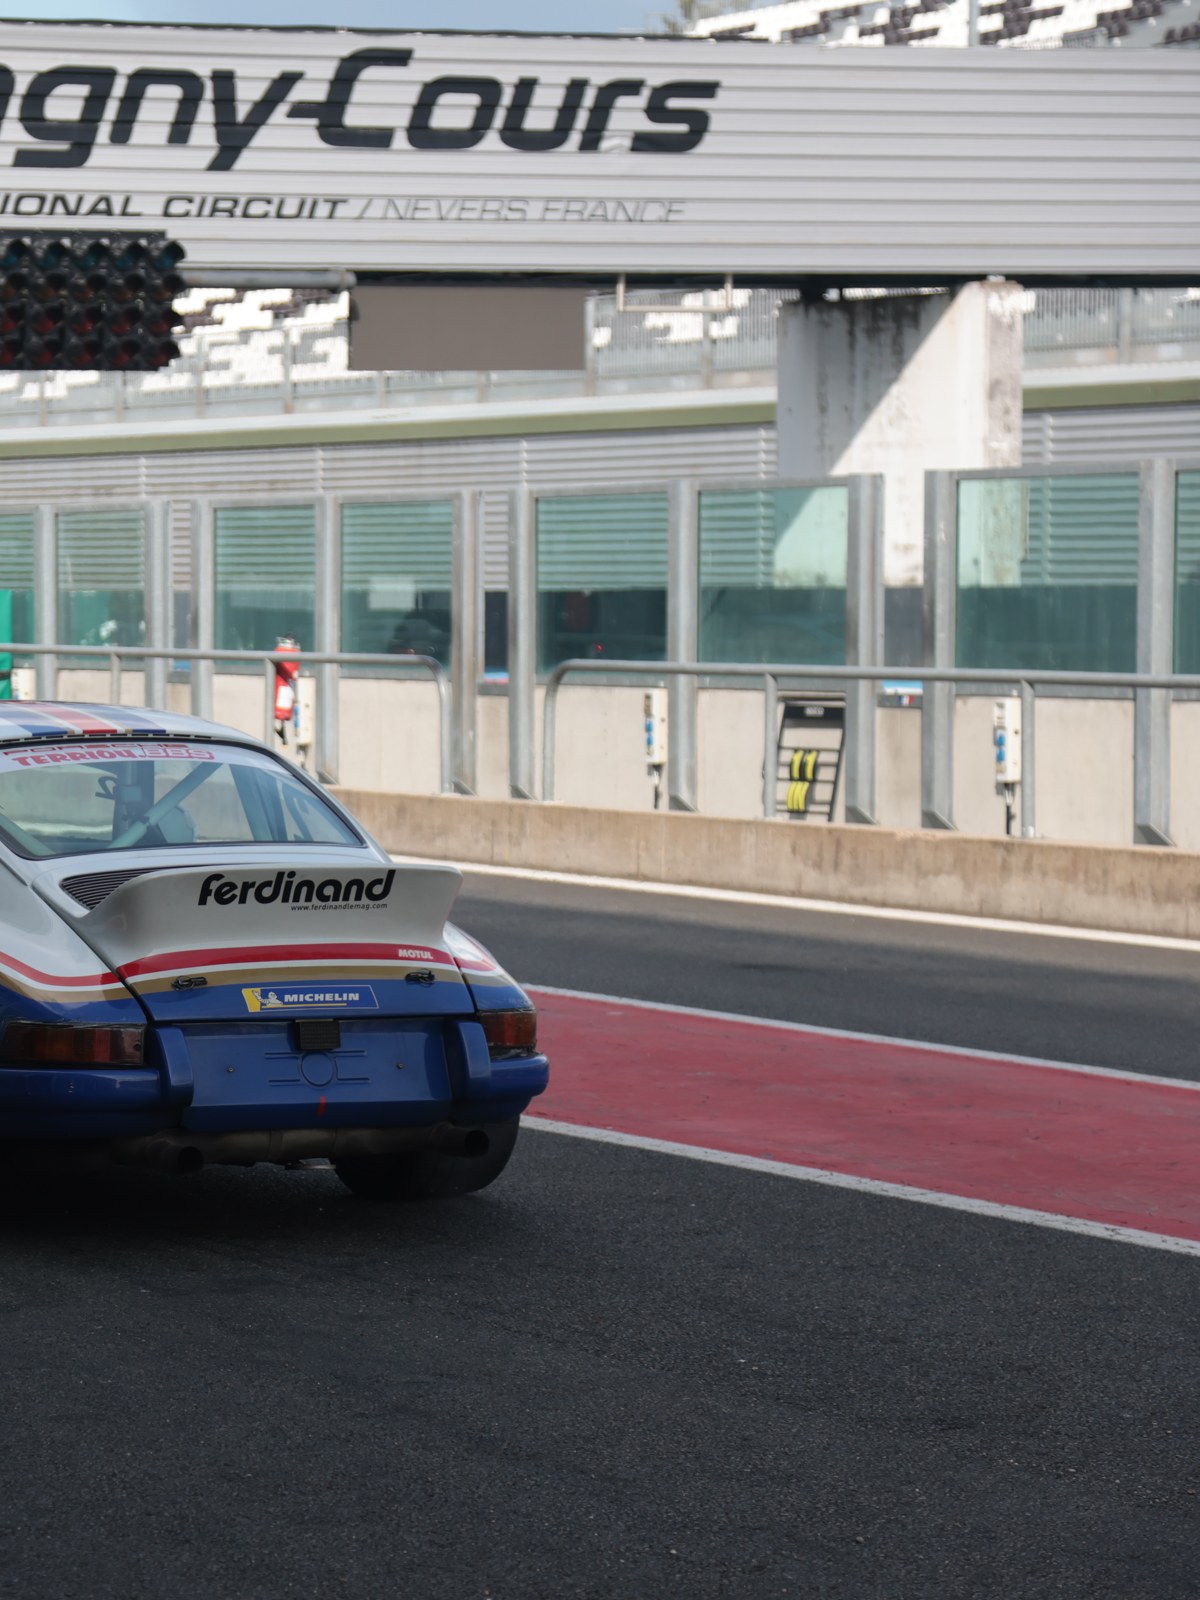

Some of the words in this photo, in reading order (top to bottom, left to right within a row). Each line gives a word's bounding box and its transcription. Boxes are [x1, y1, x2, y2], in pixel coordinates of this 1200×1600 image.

[161, 194, 350, 221] CIRCUIT
[381, 196, 529, 222] NEVERS
[540, 197, 686, 224] FRANCE
[198, 869, 397, 906] ferdinand
[290, 902, 388, 912] www.ferdinandlemag.com
[398, 949, 433, 960] MOTUL
[284, 992, 360, 1003] MICHELIN
